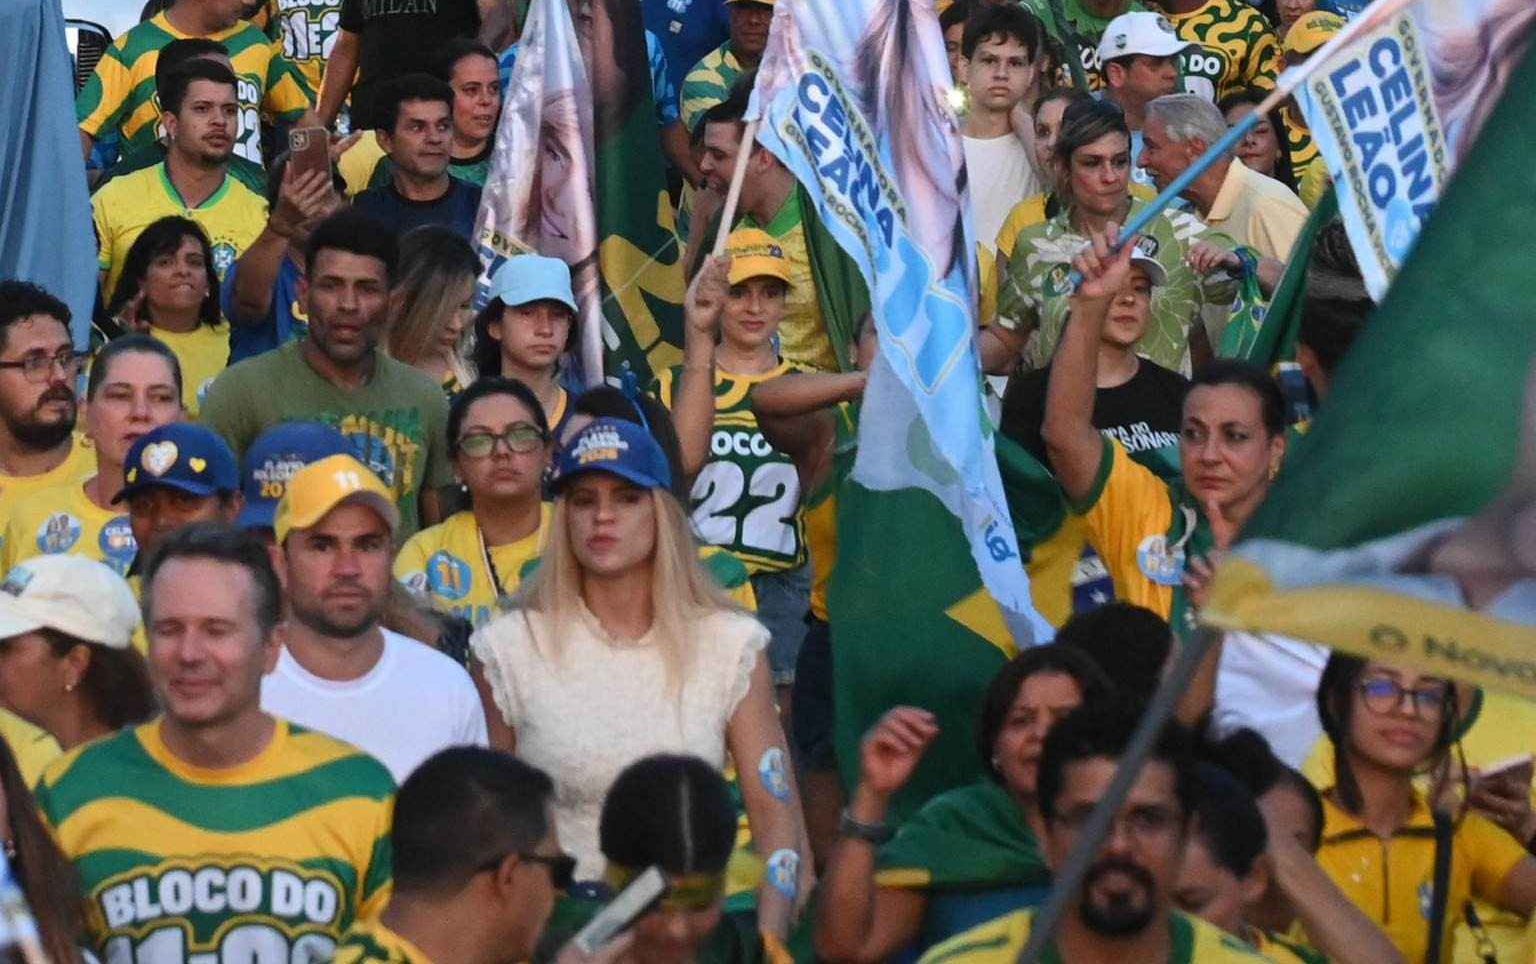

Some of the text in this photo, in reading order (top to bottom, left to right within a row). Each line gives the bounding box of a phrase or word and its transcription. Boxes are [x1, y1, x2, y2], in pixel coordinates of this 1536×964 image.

[1189, 55, 1221, 75] DO
[1398, 18, 1448, 181] GOVERNADO
[797, 71, 895, 250] CELINA
[1329, 57, 1397, 210] LEÃO
[689, 460, 801, 556] 22
[101, 866, 337, 929] BLOCO DO
